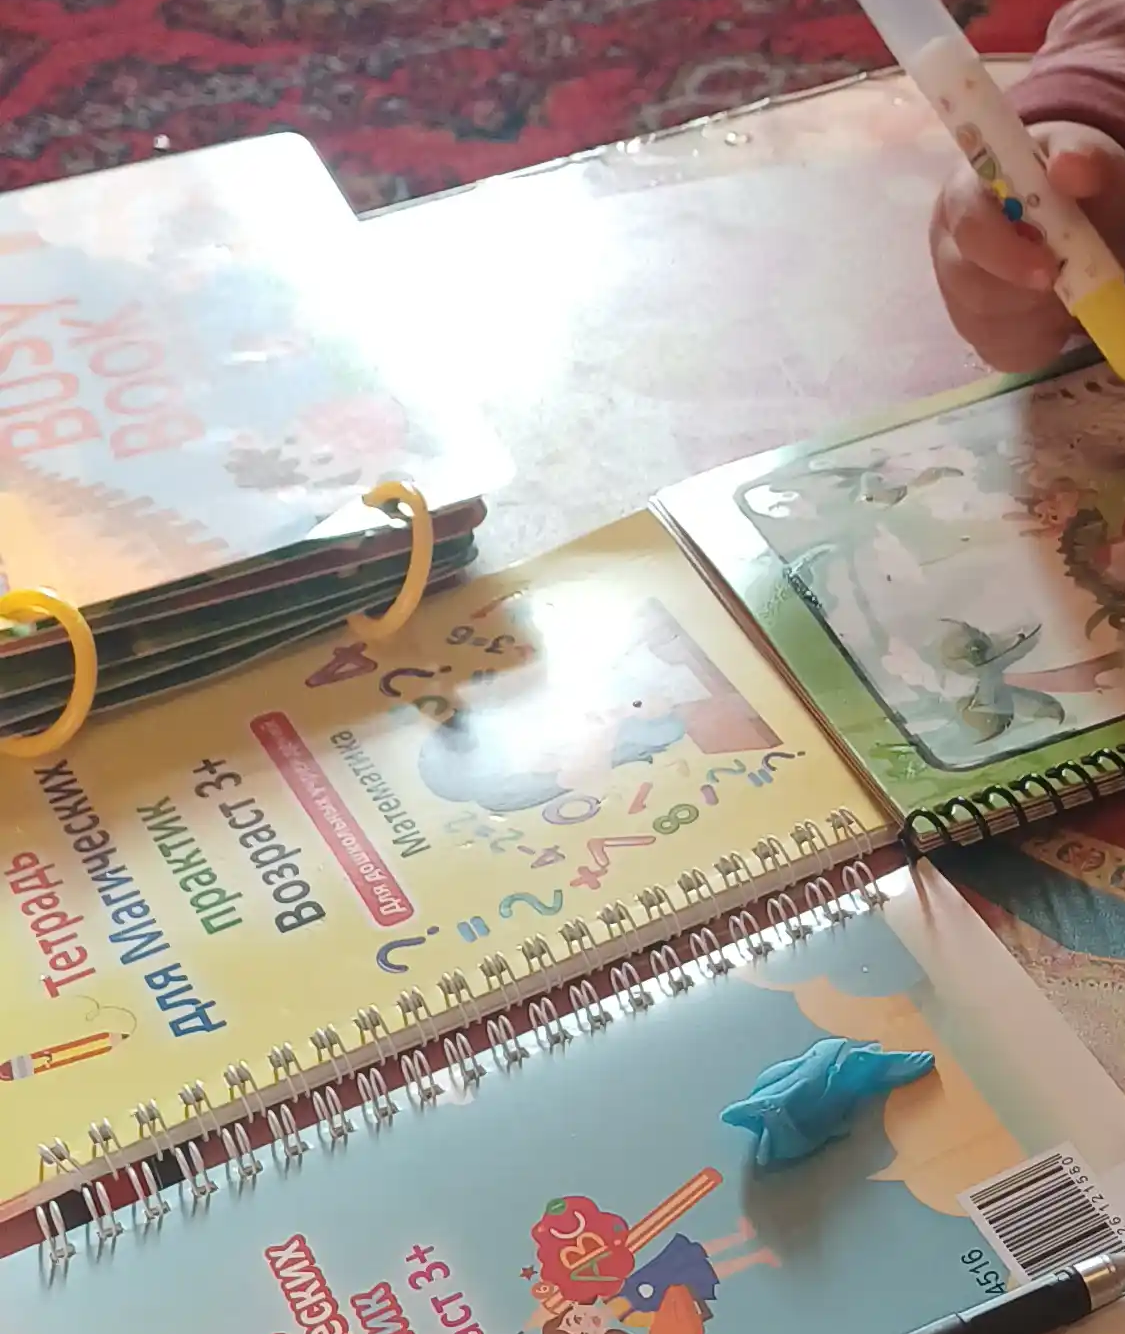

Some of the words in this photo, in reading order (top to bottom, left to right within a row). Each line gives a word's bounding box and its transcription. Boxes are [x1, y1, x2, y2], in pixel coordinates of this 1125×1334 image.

[60, 299, 206, 461] BOOK
[193, 758, 242, 800] 3+
[330, 730, 431, 859] Математика
[4, 850, 96, 998] Тетрадь
[34, 759, 171, 966] Магических
[136, 796, 244, 936] практик
[219, 797, 326, 934] Возраст
[373, 881, 408, 917] Для
[144, 962, 227, 1038] для
[405, 1243, 451, 1291] 3+
[549, 1210, 620, 1282] ABC
